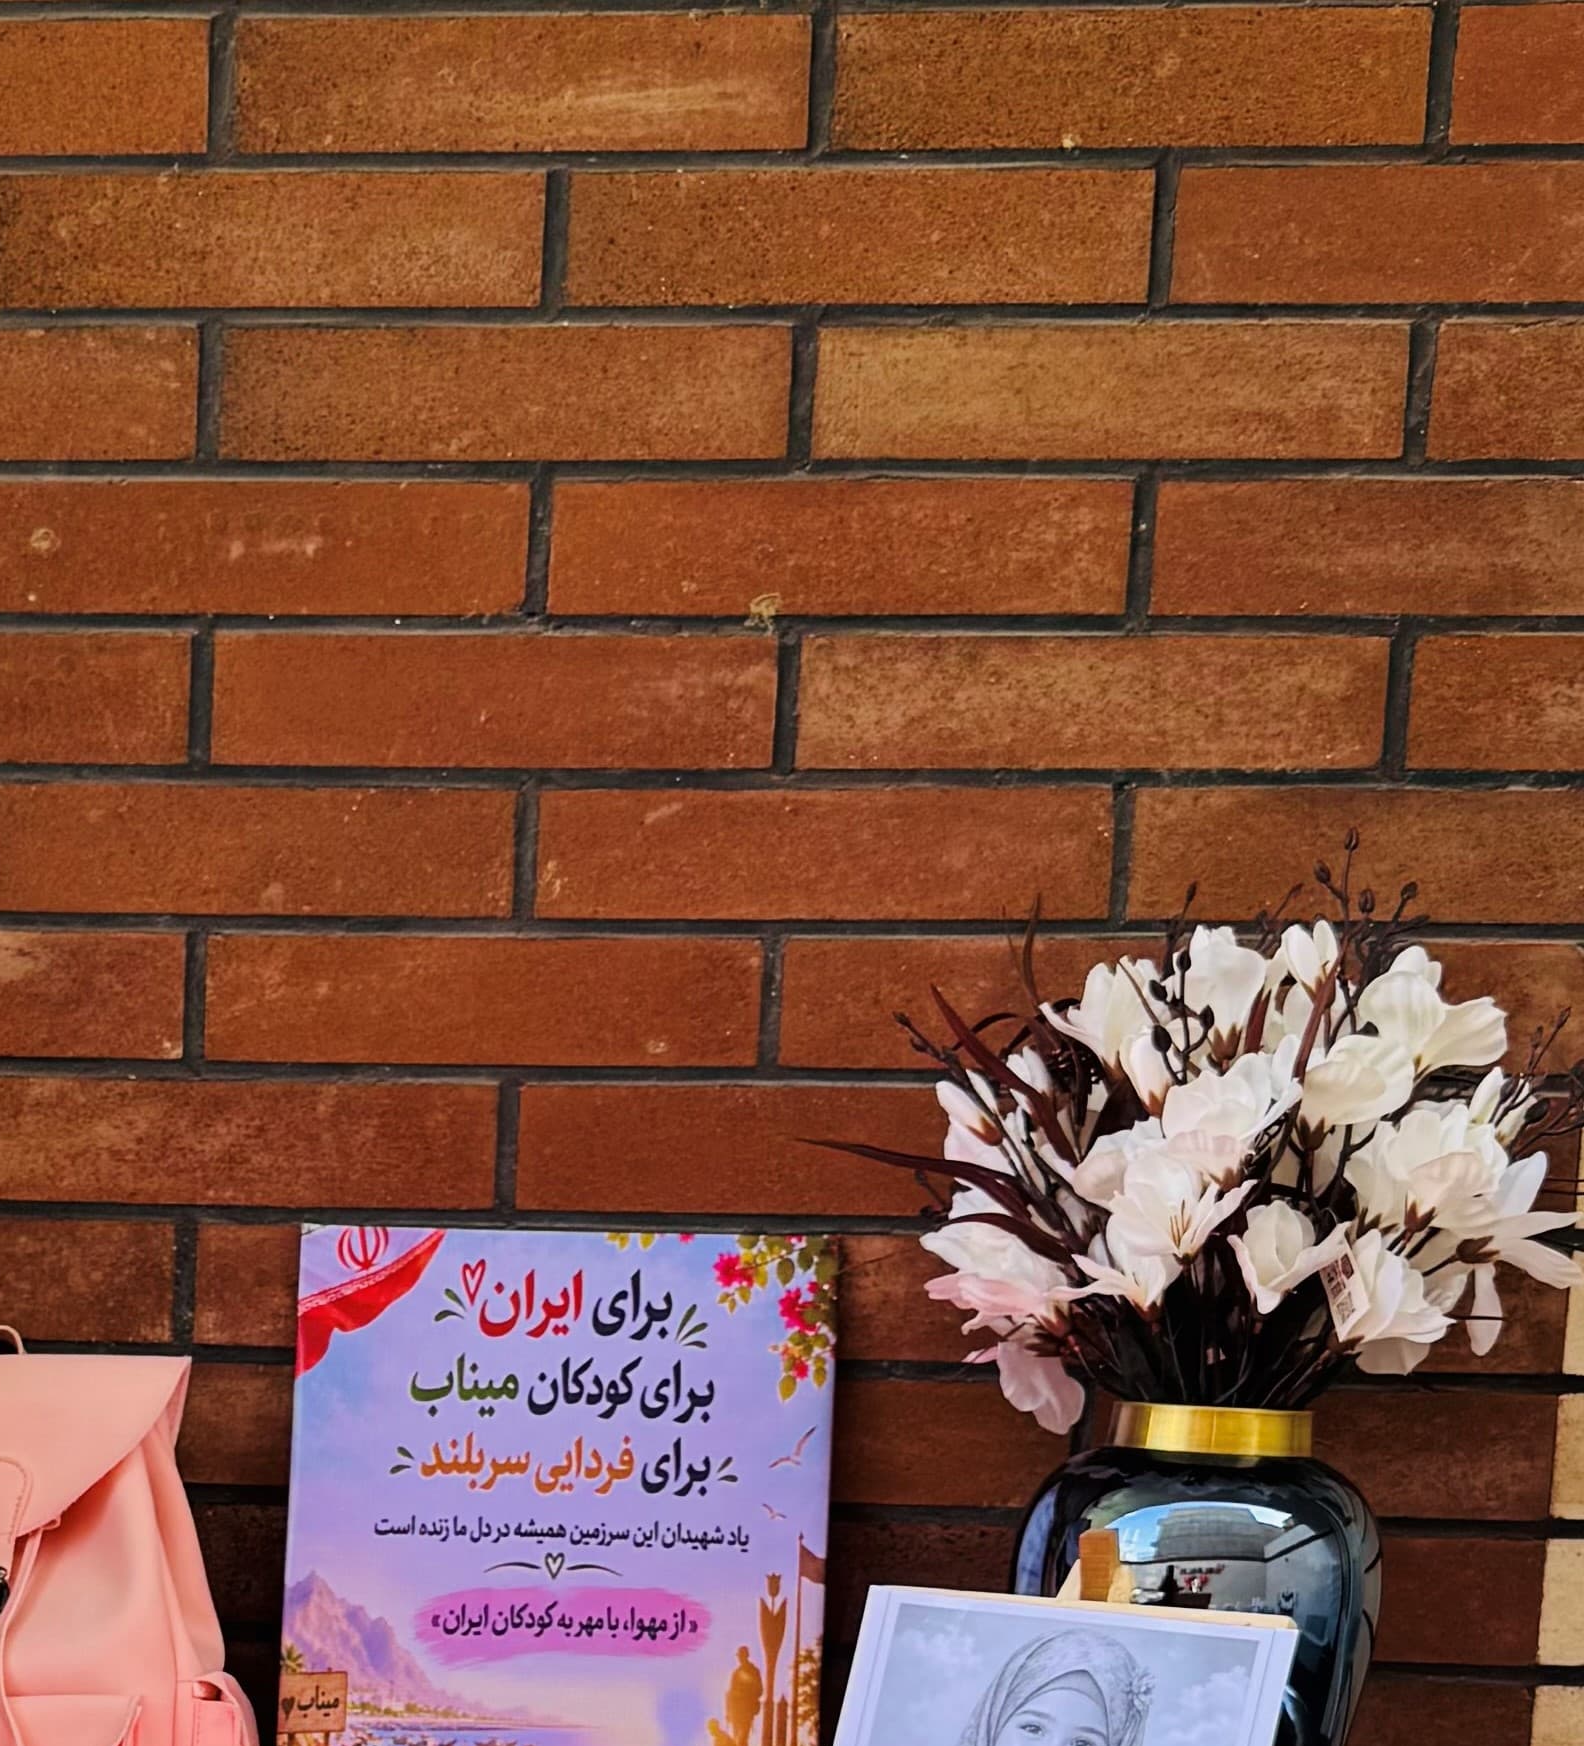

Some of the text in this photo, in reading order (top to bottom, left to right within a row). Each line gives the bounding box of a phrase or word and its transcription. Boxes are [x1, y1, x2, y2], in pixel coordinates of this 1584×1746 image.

[479, 1269, 673, 1341] برای ایران
[410, 1352, 715, 1423] برای کودکان میناب
[420, 1431, 711, 1497] برای فردایی سربلند
[374, 1514, 750, 1552] یاد شهیدان این سرزمین همیشه در دل ما زنده است
[491, 1600, 559, 1637] کودکان
[557, 1613, 573, 1637] به
[574, 1616, 604, 1637] مهر
[607, 1606, 619, 1638] با
[297, 1684, 340, 1718] میناب
